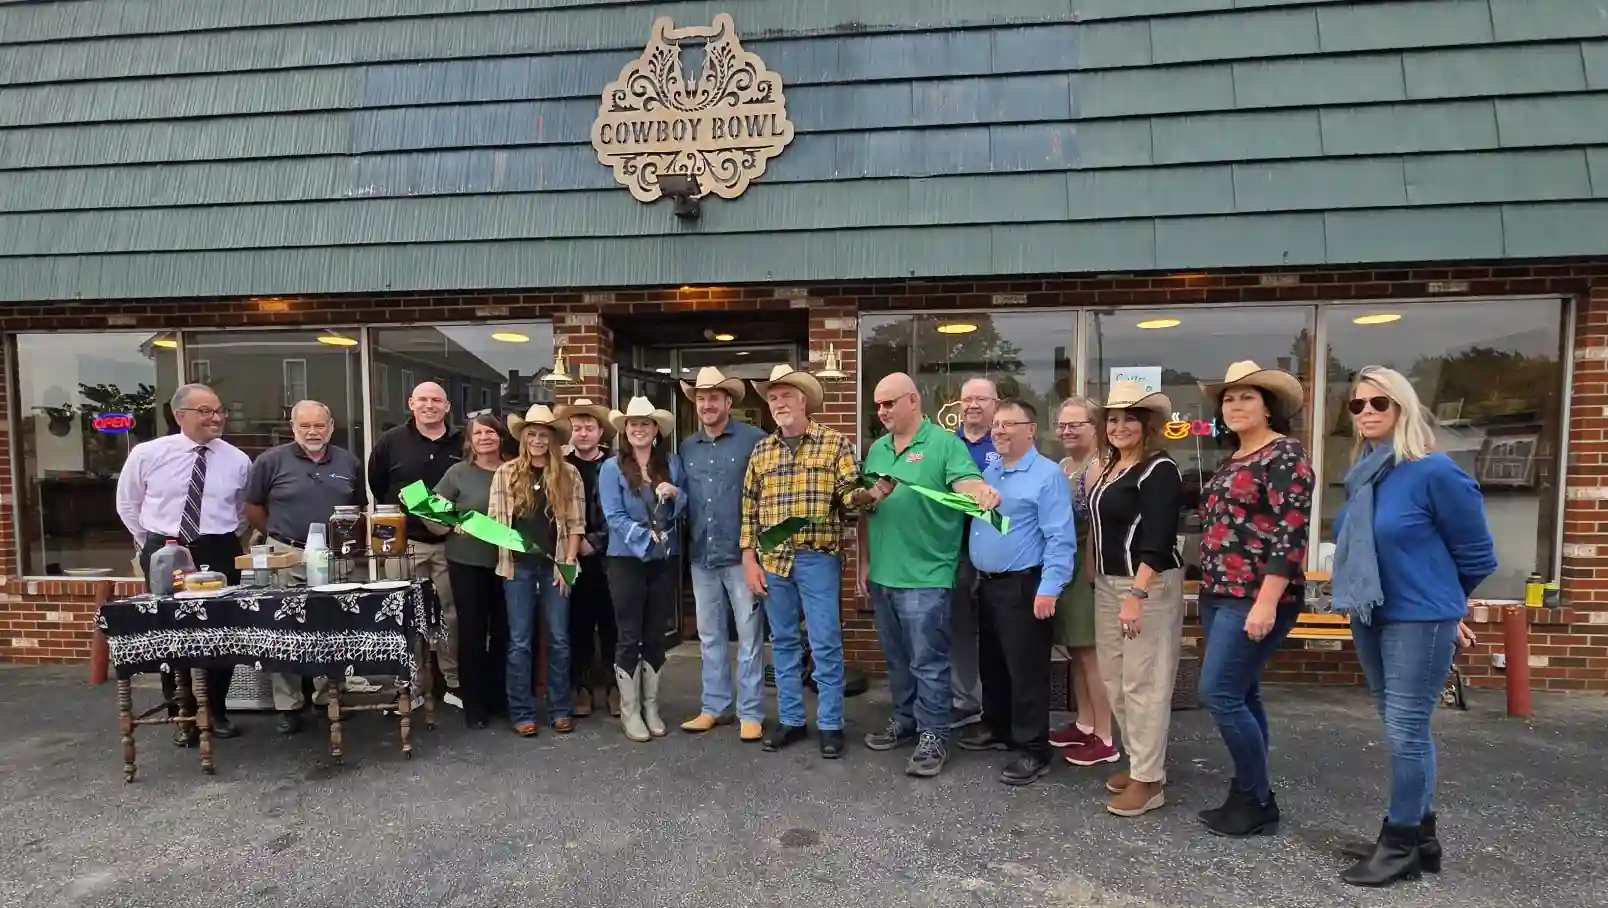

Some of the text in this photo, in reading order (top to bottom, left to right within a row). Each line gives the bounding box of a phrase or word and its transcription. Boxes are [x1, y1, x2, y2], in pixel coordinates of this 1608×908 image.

[600, 113, 785, 145] COWBOY BOWL
[94, 416, 130, 429] OPEN
